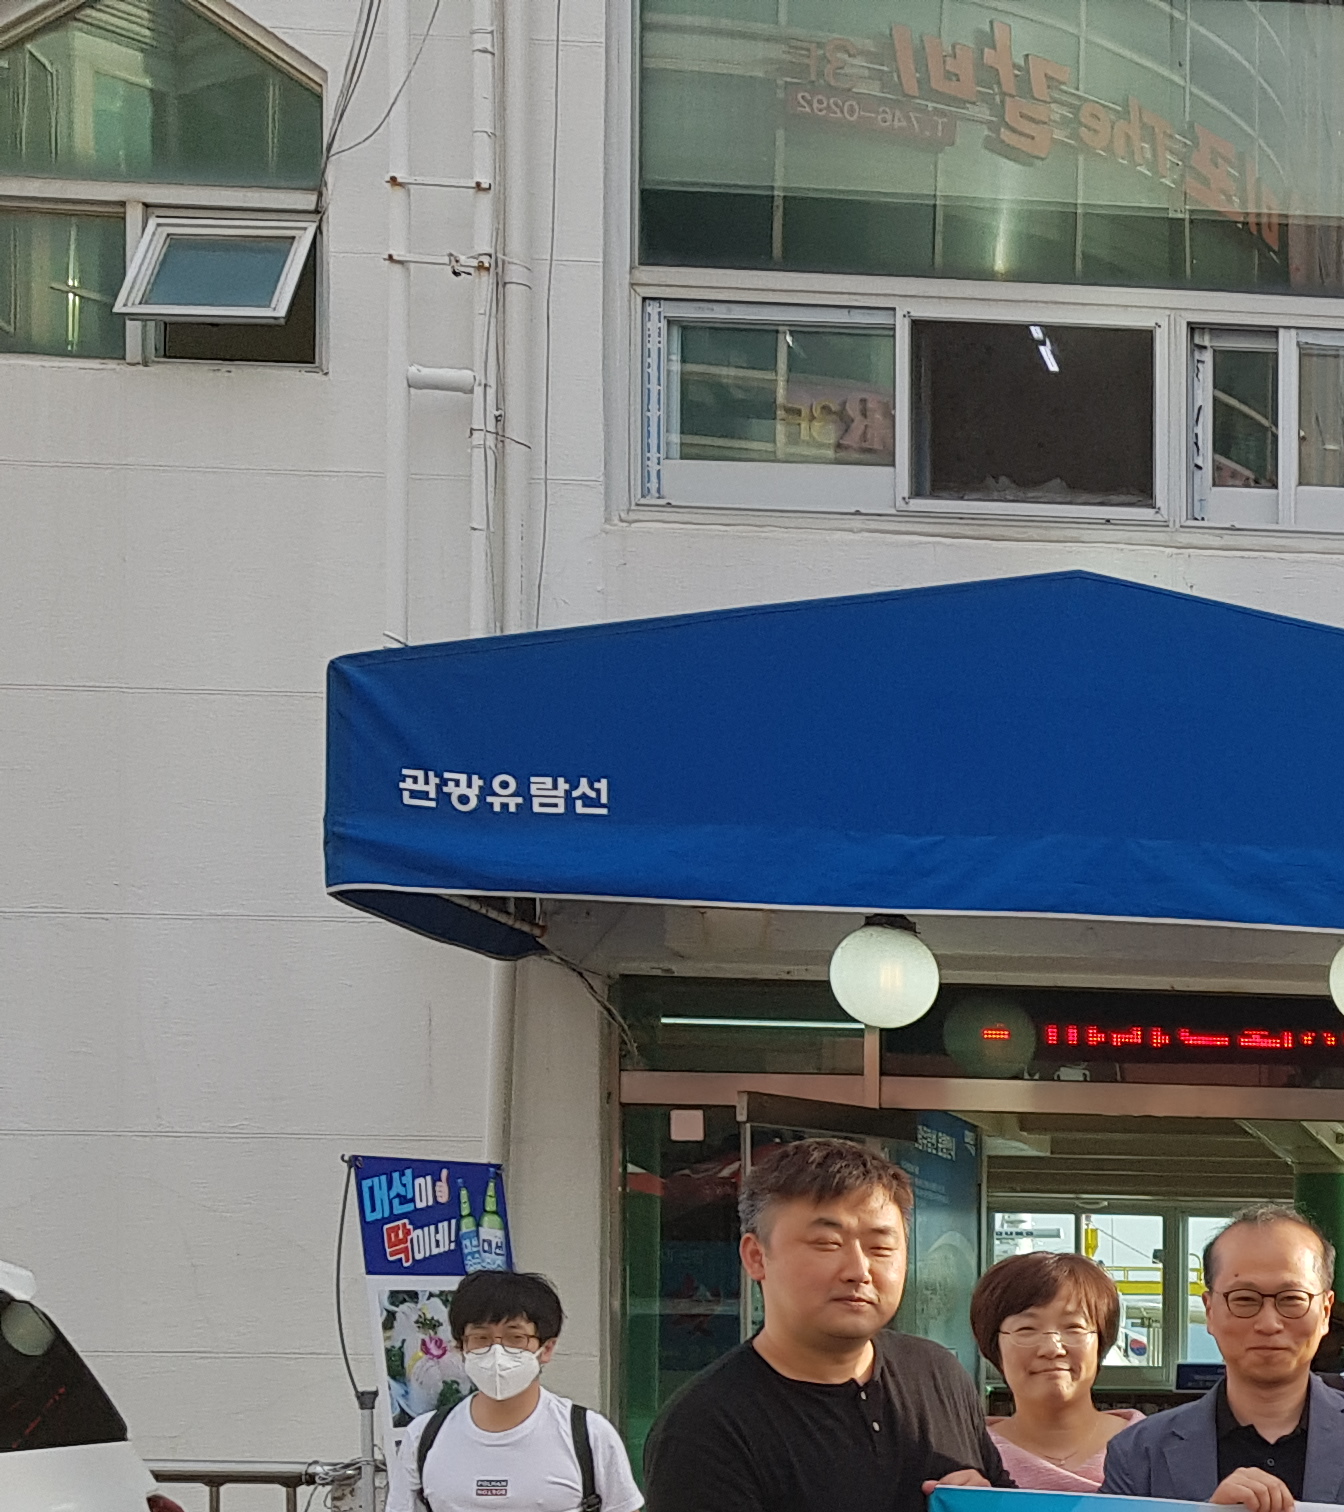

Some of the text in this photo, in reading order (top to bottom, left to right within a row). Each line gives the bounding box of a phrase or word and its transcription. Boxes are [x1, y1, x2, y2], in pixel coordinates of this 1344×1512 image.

[399, 768, 610, 815] 관광유람선
[361, 1168, 434, 1222] 대선이
[383, 1218, 457, 1267] 딱이네!
